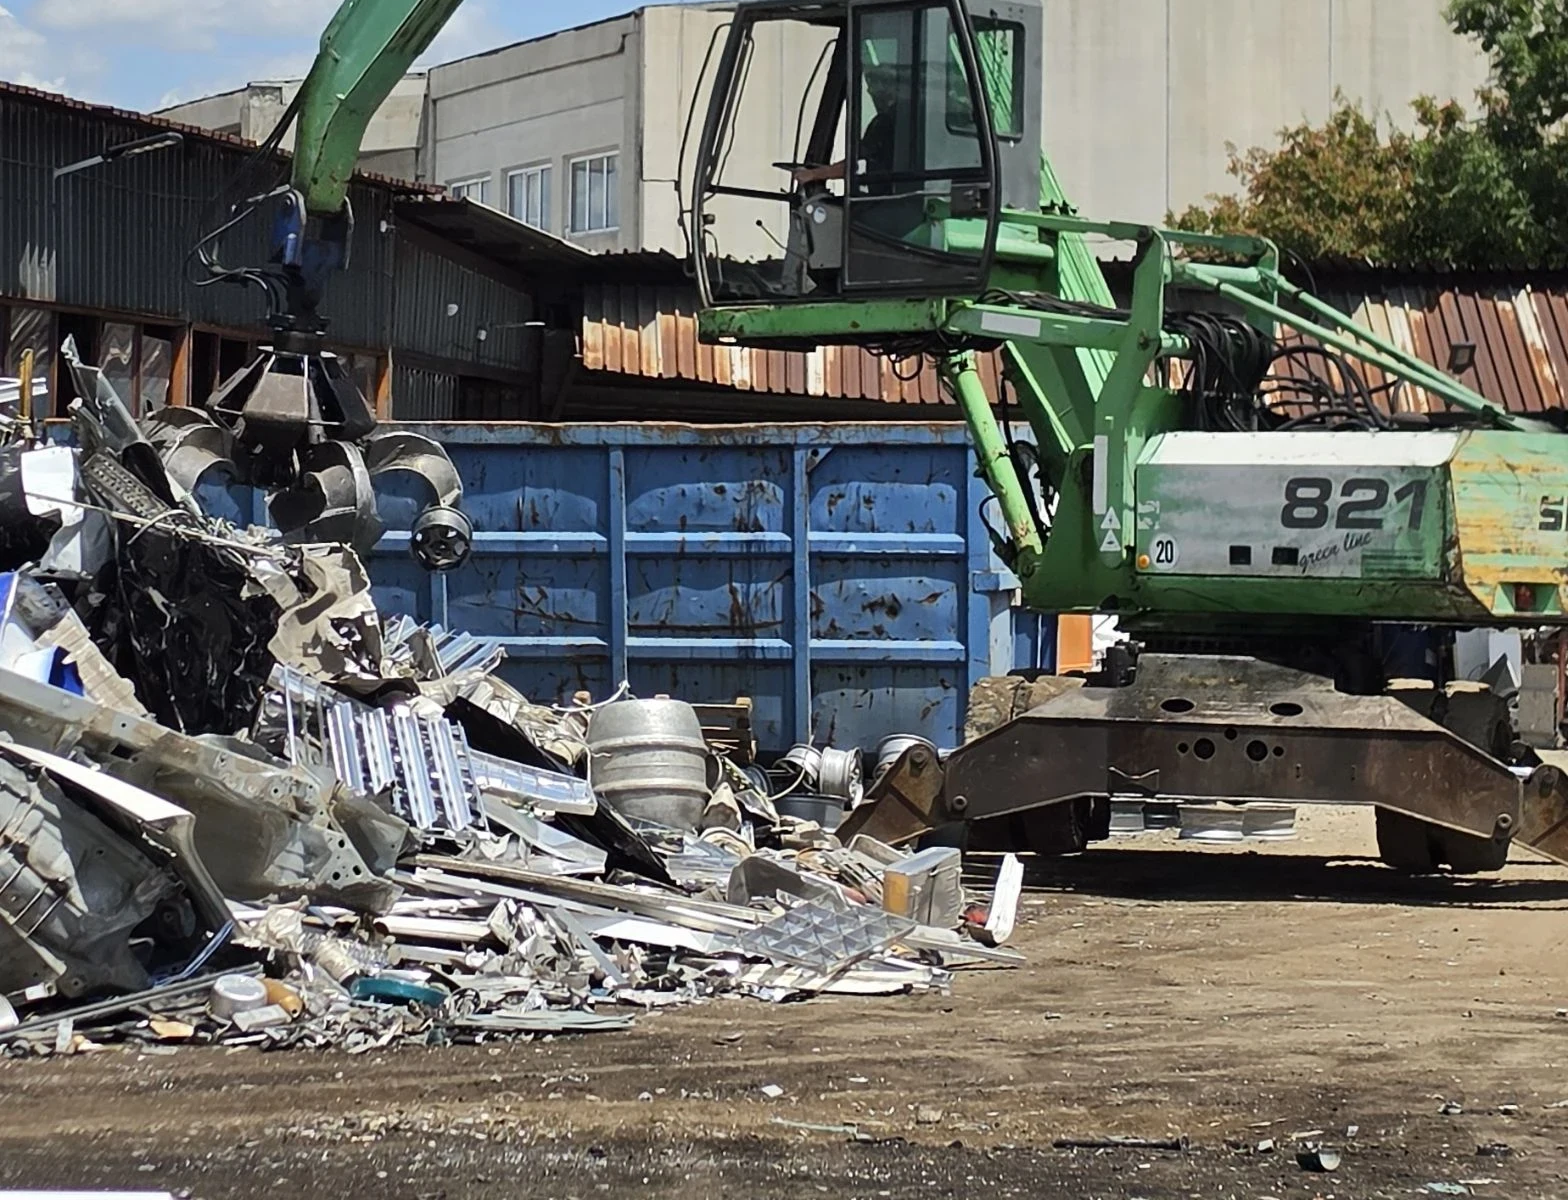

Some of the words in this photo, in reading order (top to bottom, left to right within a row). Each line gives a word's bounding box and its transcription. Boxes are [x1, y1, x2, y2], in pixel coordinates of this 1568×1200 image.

[1281, 477, 1428, 530] 821
[1156, 539, 1174, 564] 20
[1299, 545, 1340, 574] green
[1344, 532, 1372, 551] line
